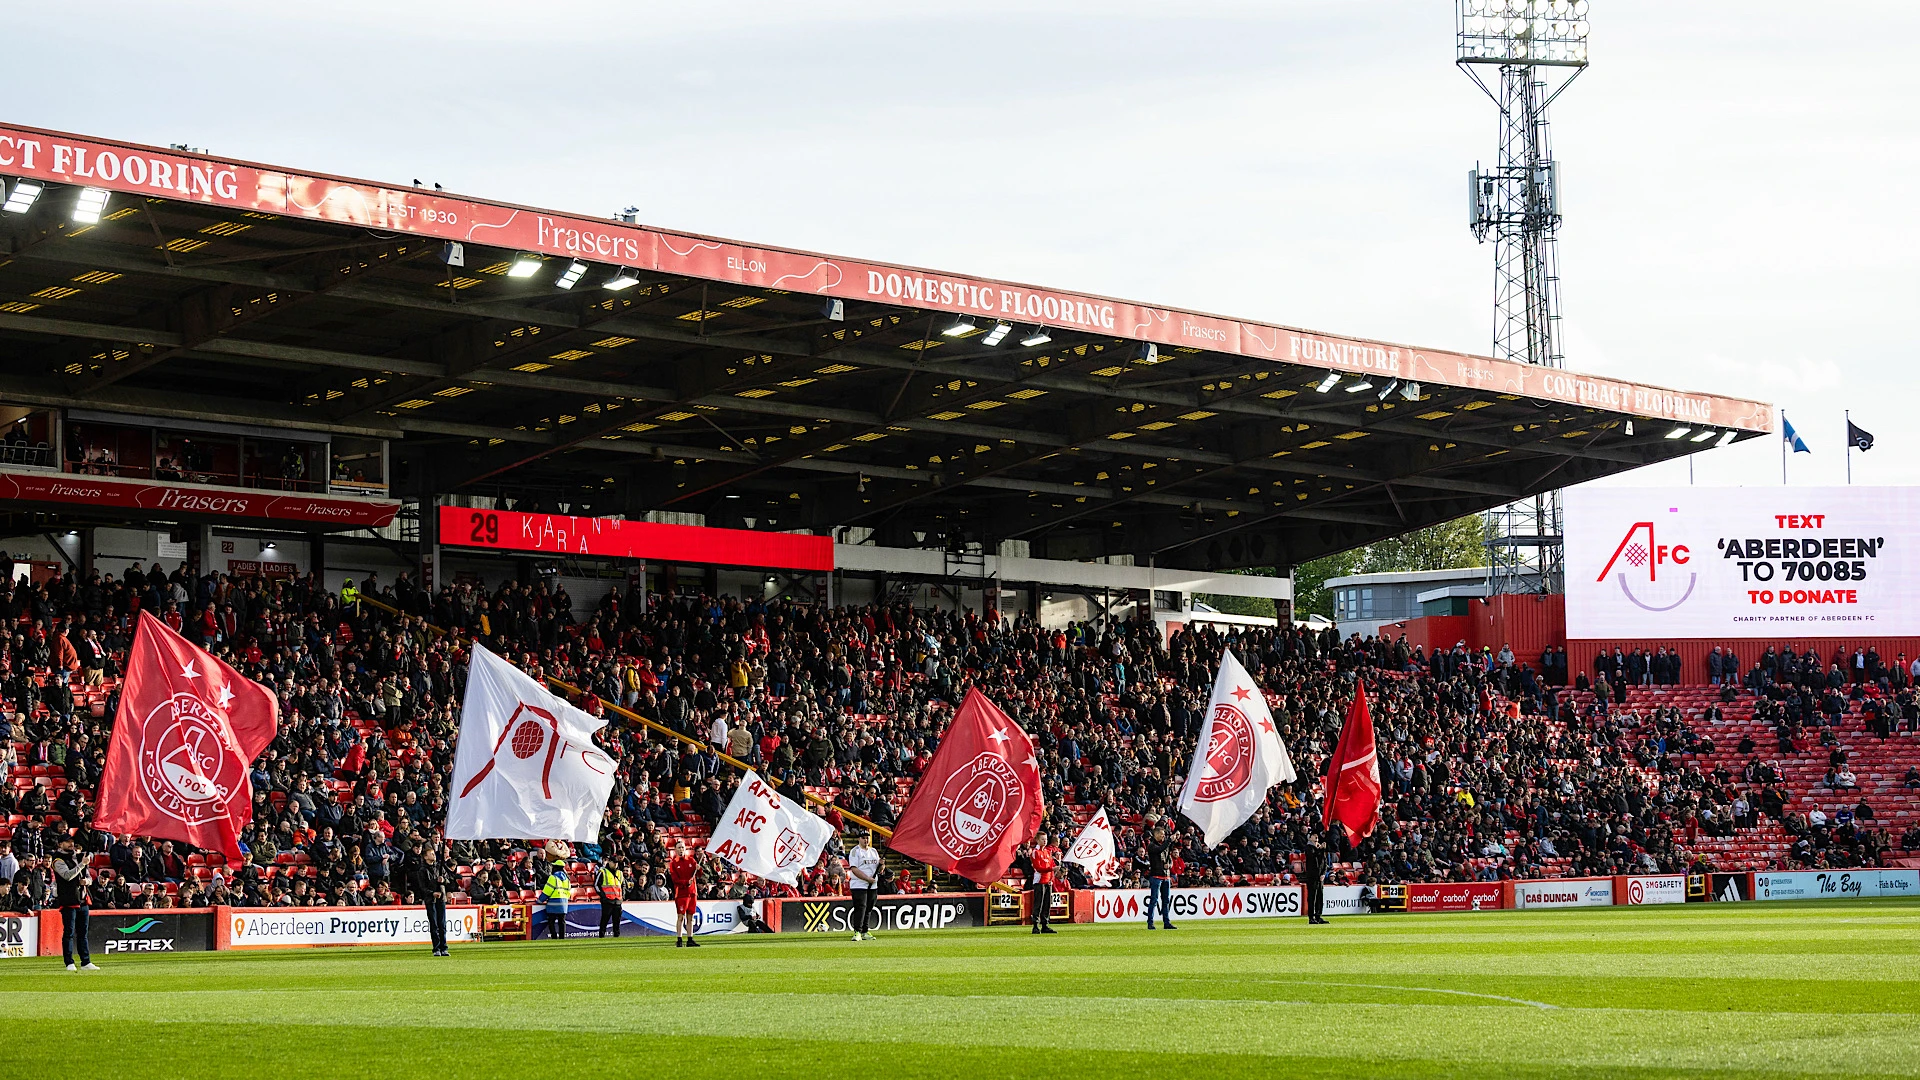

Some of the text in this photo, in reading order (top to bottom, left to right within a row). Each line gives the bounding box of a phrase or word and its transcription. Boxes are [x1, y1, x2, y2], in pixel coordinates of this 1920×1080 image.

[0, 136, 238, 199] CT FLOORING
[388, 203, 458, 225] EST 1930
[537, 216, 639, 260] Frasers
[727, 256, 767, 273] ELLON
[867, 270, 1115, 330] DOMESTIC FLOORING
[1182, 320, 1227, 342] Frasers
[1289, 335, 1399, 372] FURNITURE
[1457, 362, 1494, 381] Frasers
[1543, 374, 1712, 419] CONTRACT FLOORING
[50, 483, 102, 498] Frasers
[157, 489, 249, 513] Frasers
[305, 503, 352, 517] Frasers
[470, 512, 499, 544] 29
[1775, 515, 1825, 529] TEXT
[222, 542, 233, 552] 22
[265, 564, 294, 573] LADIES
[1737, 561, 1867, 581] TO 70085
[1748, 589, 1858, 604] TO DONATE
[1214, 709, 1250, 757] BERDEEN
[971, 756, 1019, 797] ABERDEEN
[1202, 778, 1235, 796] CLUB
[734, 807, 766, 833] AFC
[937, 796, 973, 856] FOOTBALL
[961, 819, 982, 835] 1903
[977, 822, 1004, 852] CLUB
[715, 839, 747, 864] AFC
[1390, 887, 1398, 896] 23
[1646, 880, 1683, 889] SMGSAFETY
[1817, 873, 1862, 896] The Bay
[1879, 879, 1889, 889] Fish
[1894, 879, 1909, 890] Chips
[1001, 894, 1011, 904] 22
[1053, 894, 1061, 903] 22
[1246, 892, 1299, 914] swes
[1412, 894, 1436, 903] carbon
[1442, 894, 1467, 903] carbon
[1472, 893, 1496, 902] carbon
[1525, 893, 1578, 904] CAS DUNCAN
[500, 908, 511, 919] 21
[706, 913, 732, 924] HCS
[248, 916, 462, 937] Aberdeen Property Leang
[105, 938, 175, 955] PETREX
